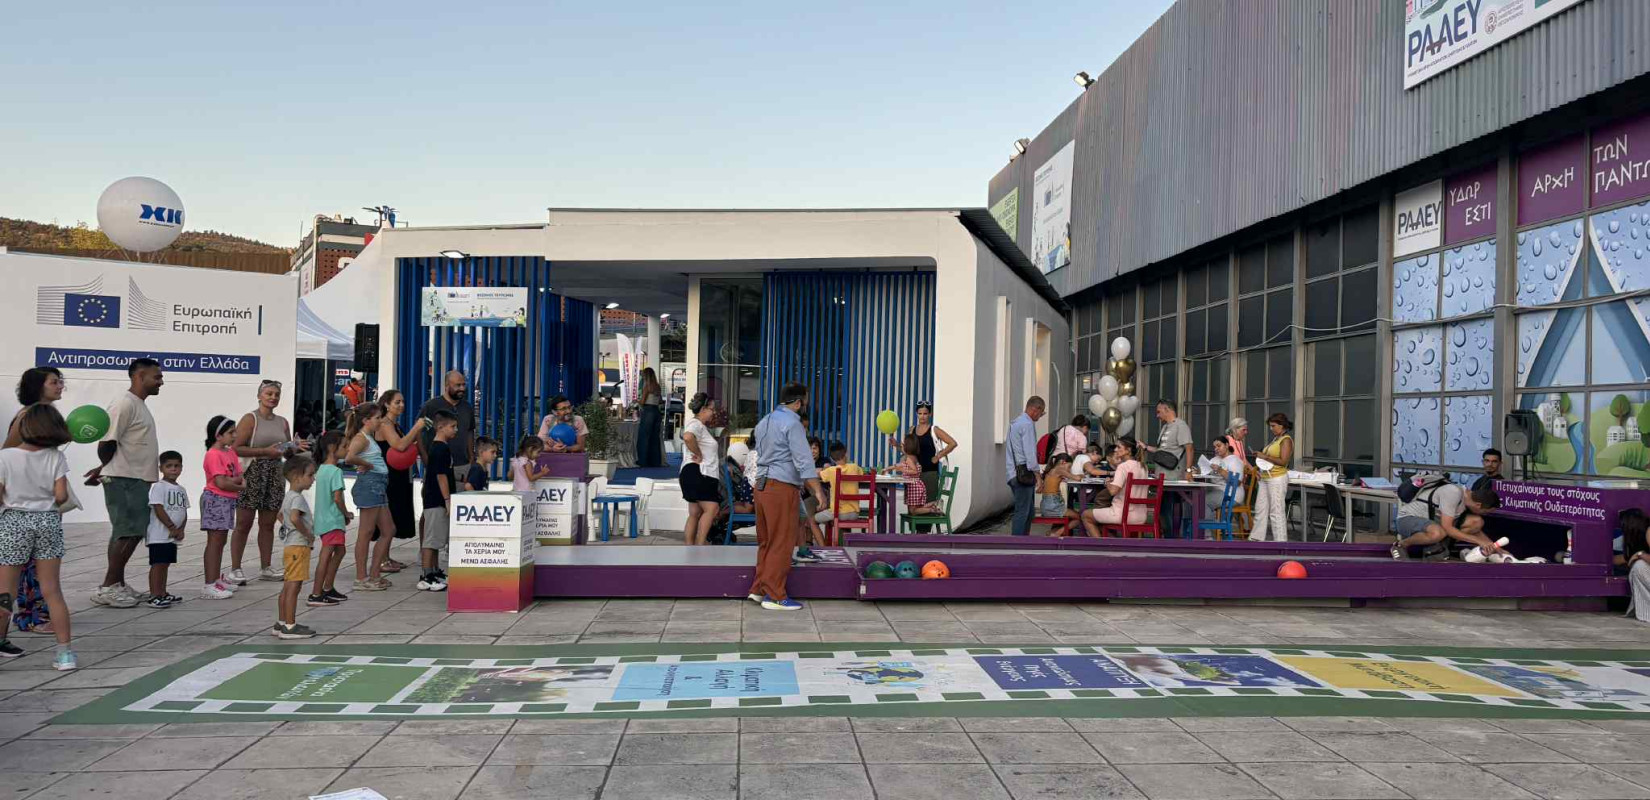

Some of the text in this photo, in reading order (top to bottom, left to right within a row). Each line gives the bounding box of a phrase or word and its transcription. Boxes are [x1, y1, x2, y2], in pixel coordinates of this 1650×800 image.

[1594, 133, 1628, 164] ΤΩΝ
[1449, 181, 1481, 206] ΥΔΩΡ
[1465, 202, 1491, 226] ΕΣΤΙ
[173, 304, 252, 319] Ευρωπαϊκή
[173, 321, 237, 335] Επιτροπή
[48, 351, 249, 370] Αντιπροσωπ στην Ελλάδα
[1496, 480, 1600, 503] Πετυχαίνουμε τους στόχους
[1505, 496, 1542, 512] Κλιματικής
[1545, 500, 1606, 520] Ουδετερότητας
